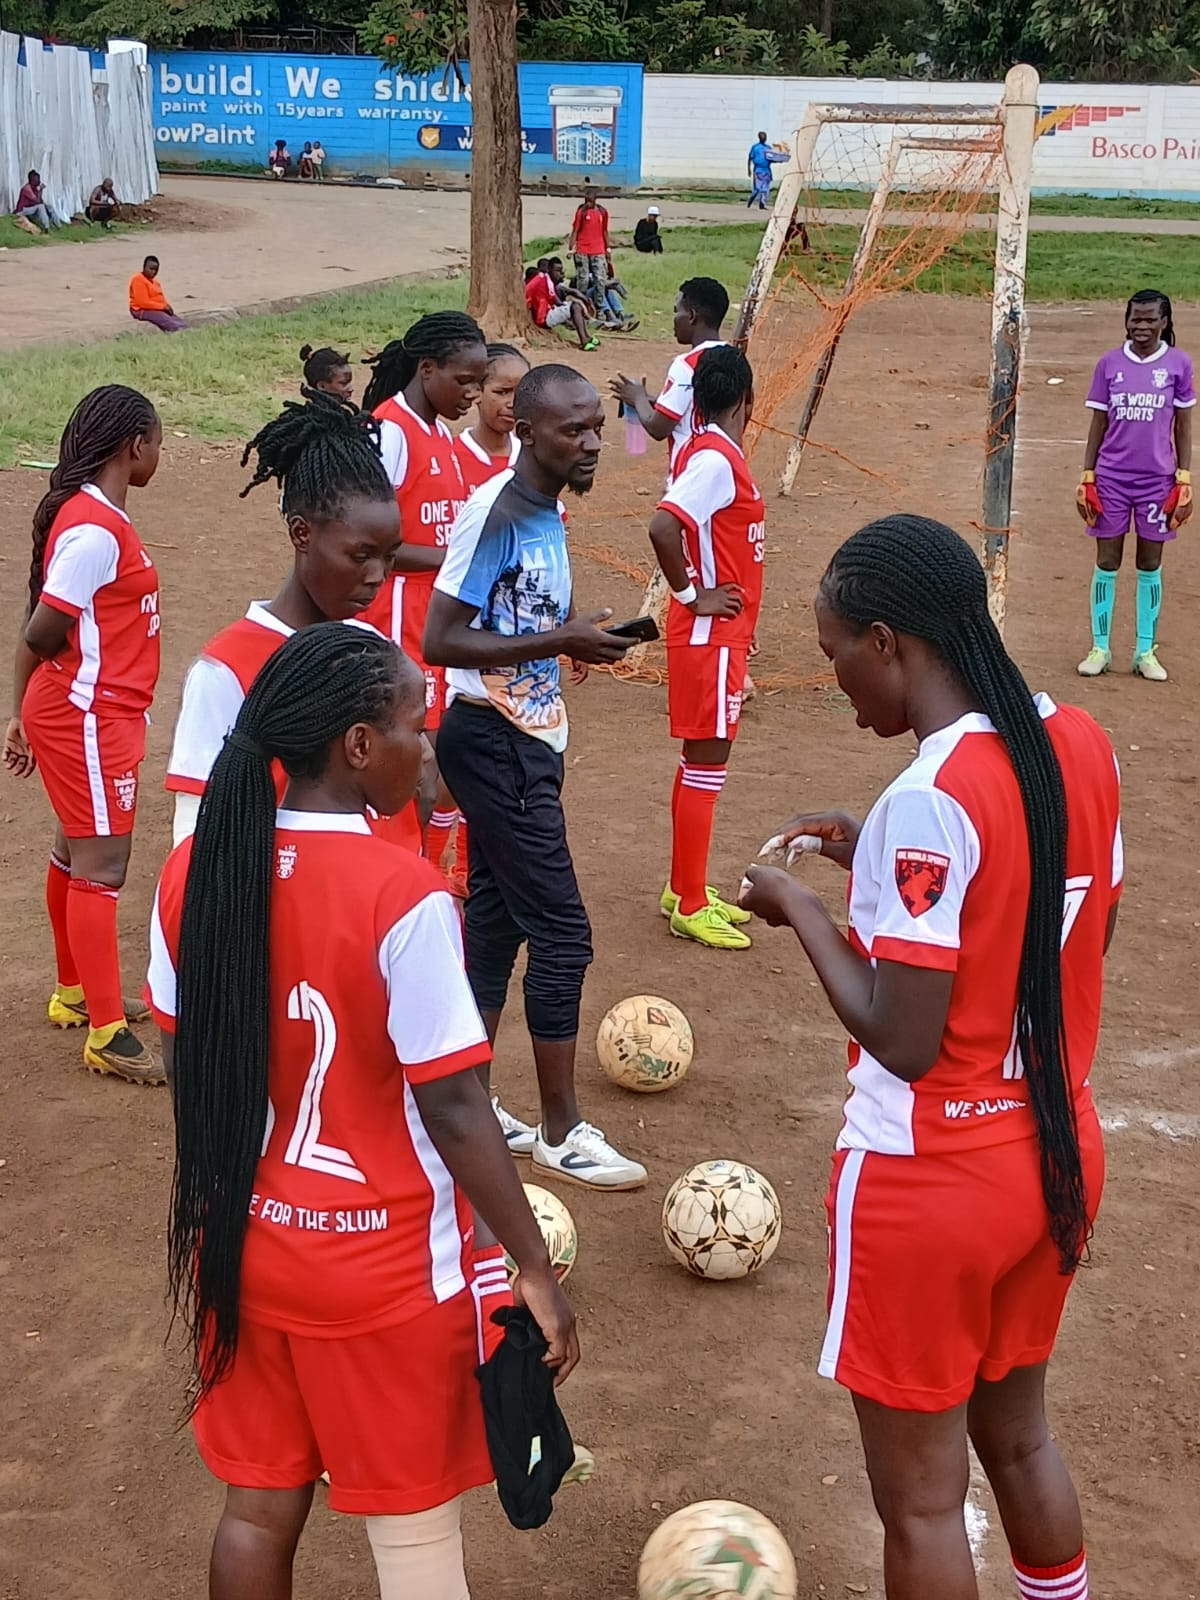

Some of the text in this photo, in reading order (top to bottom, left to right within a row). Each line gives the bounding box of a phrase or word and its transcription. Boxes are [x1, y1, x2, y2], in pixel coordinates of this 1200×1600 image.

[160, 63, 262, 96] build.
[285, 66, 341, 98] We
[161, 98, 208, 116] paint
[223, 100, 263, 115] with
[357, 107, 448, 124] warranty.
[153, 122, 256, 145] owPaint
[1116, 406, 1155, 421] SPORTS
[1128, 393, 1165, 408] WORLD
[420, 499, 450, 525] ONE
[260, 980, 367, 1184] 2
[944, 1099, 974, 1119] WE
[260, 1198, 292, 1227] FOR
[295, 1207, 330, 1232] THE
[335, 1208, 387, 1233] SLUM
